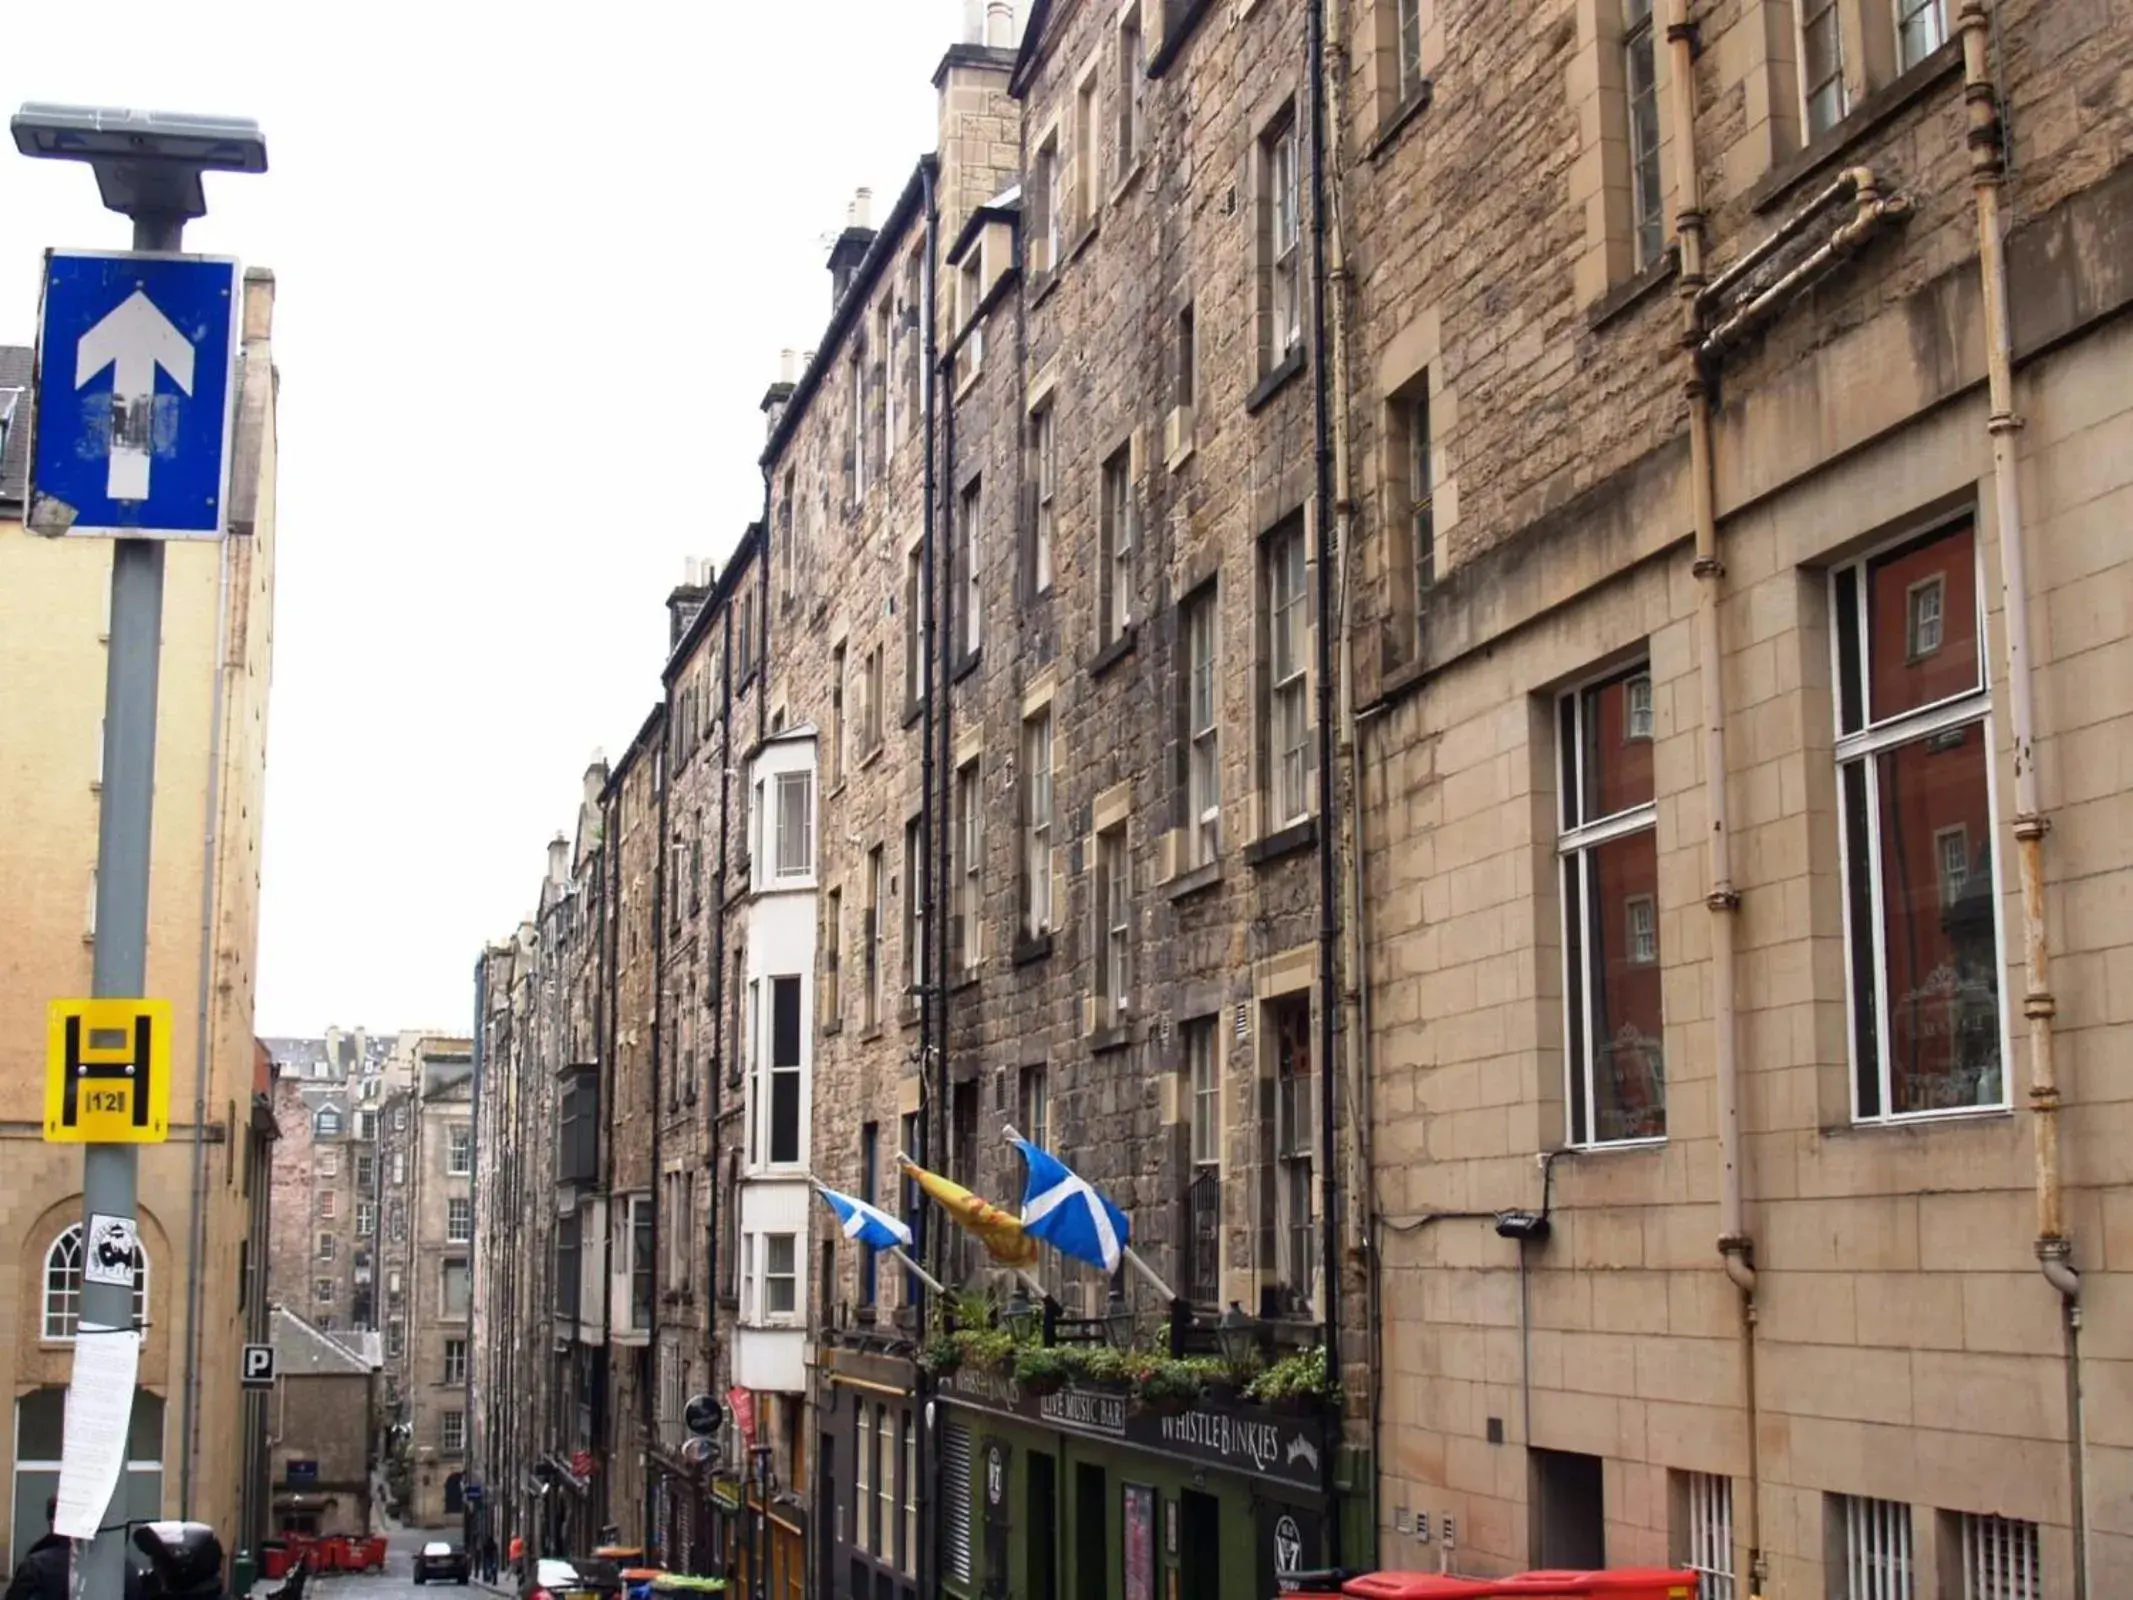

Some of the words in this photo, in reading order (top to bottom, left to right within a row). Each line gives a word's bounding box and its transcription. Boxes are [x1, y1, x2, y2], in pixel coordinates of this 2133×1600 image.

[247, 1349, 270, 1377] P
[1043, 1391, 1064, 1417] LIVE
[1066, 1394, 1099, 1424] MUSIC
[1101, 1399, 1122, 1428] BAR
[1161, 1411, 1279, 1471] WHISTLEBINKIES
